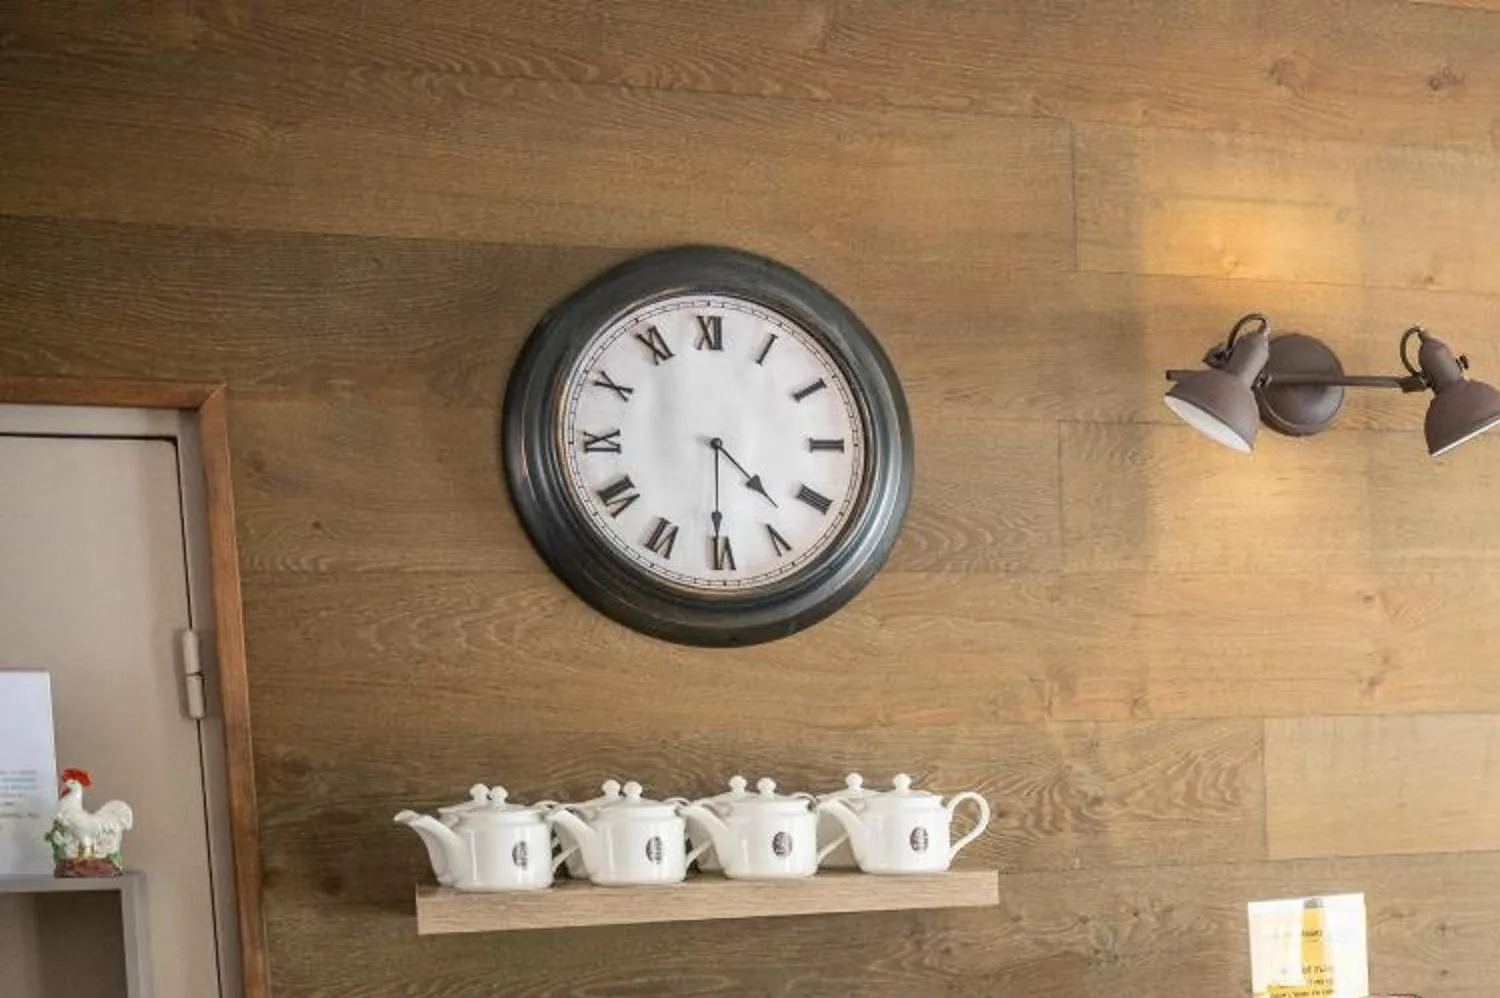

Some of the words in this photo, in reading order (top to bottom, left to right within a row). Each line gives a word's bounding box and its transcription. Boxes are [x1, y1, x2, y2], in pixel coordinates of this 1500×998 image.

[636, 325, 676, 365] XI
[696, 315, 725, 351] XII
[755, 333, 779, 366] I
[592, 371, 634, 402] X
[583, 429, 622, 454] IX
[643, 517, 680, 560] VII
[766, 523, 793, 557] V
